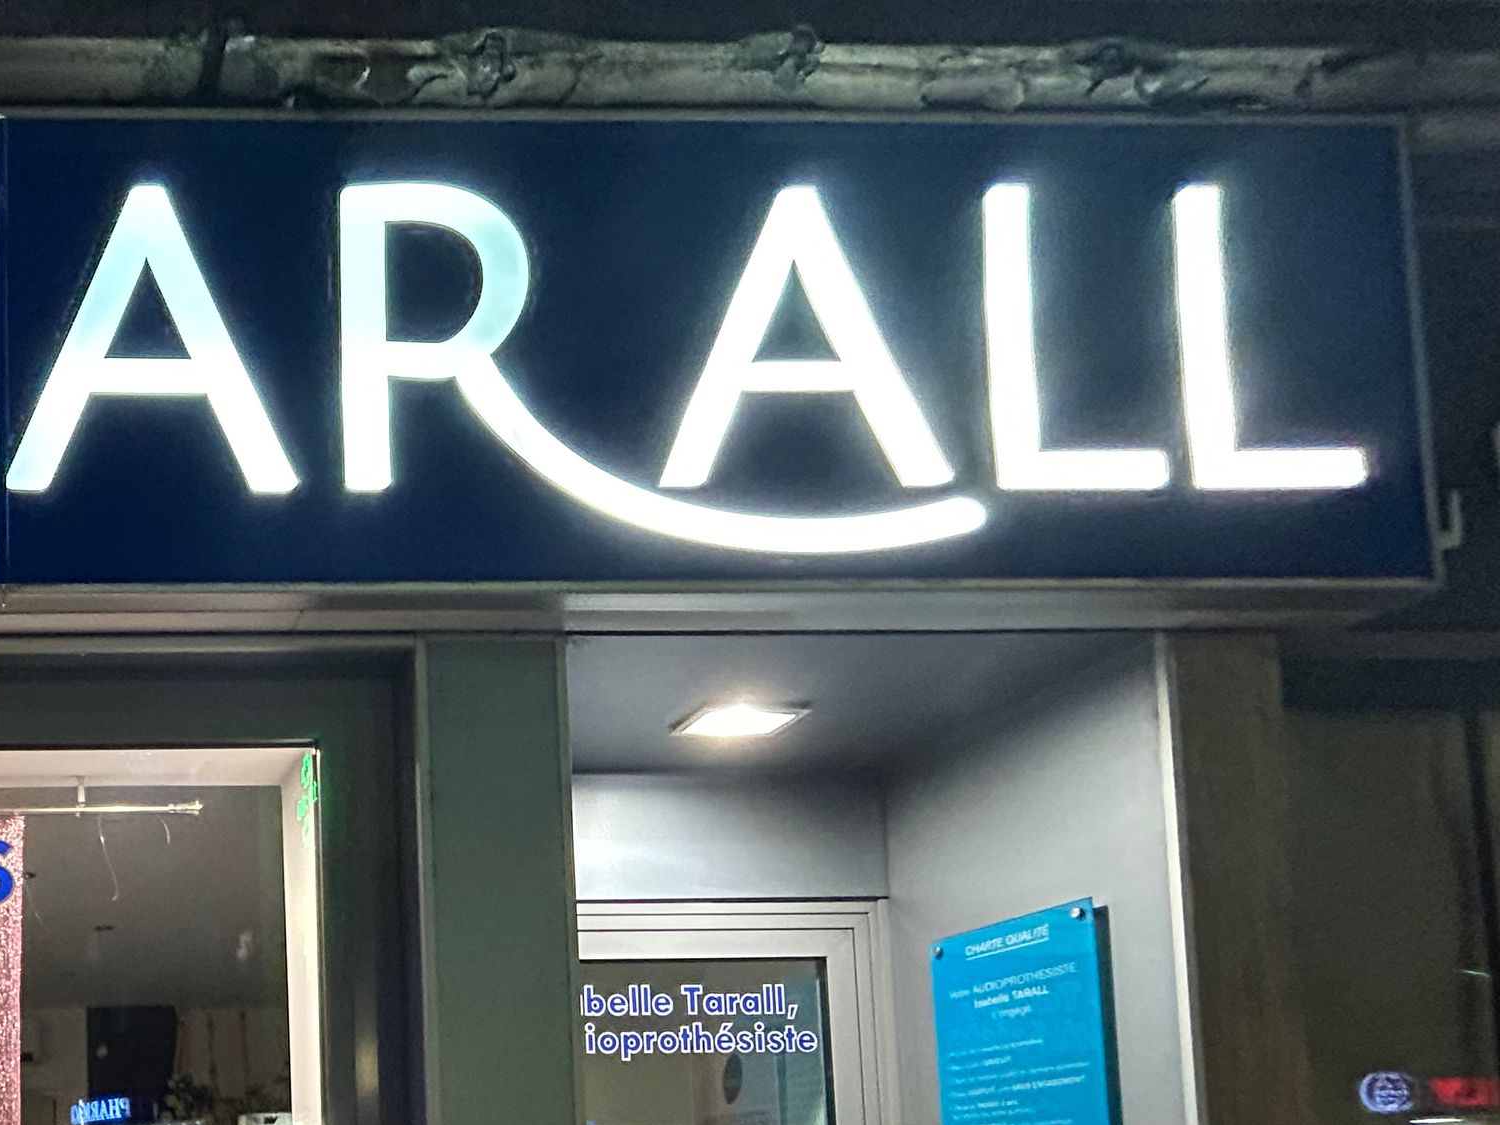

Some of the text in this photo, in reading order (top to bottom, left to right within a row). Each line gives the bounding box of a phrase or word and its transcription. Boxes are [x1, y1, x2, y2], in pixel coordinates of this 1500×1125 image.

[964, 922, 1050, 957] CHARTE QUALITÉ
[580, 983, 799, 1020] belle Tarall,
[1011, 984, 1050, 1000] TARALL
[584, 1021, 818, 1062] ioprothésiste
